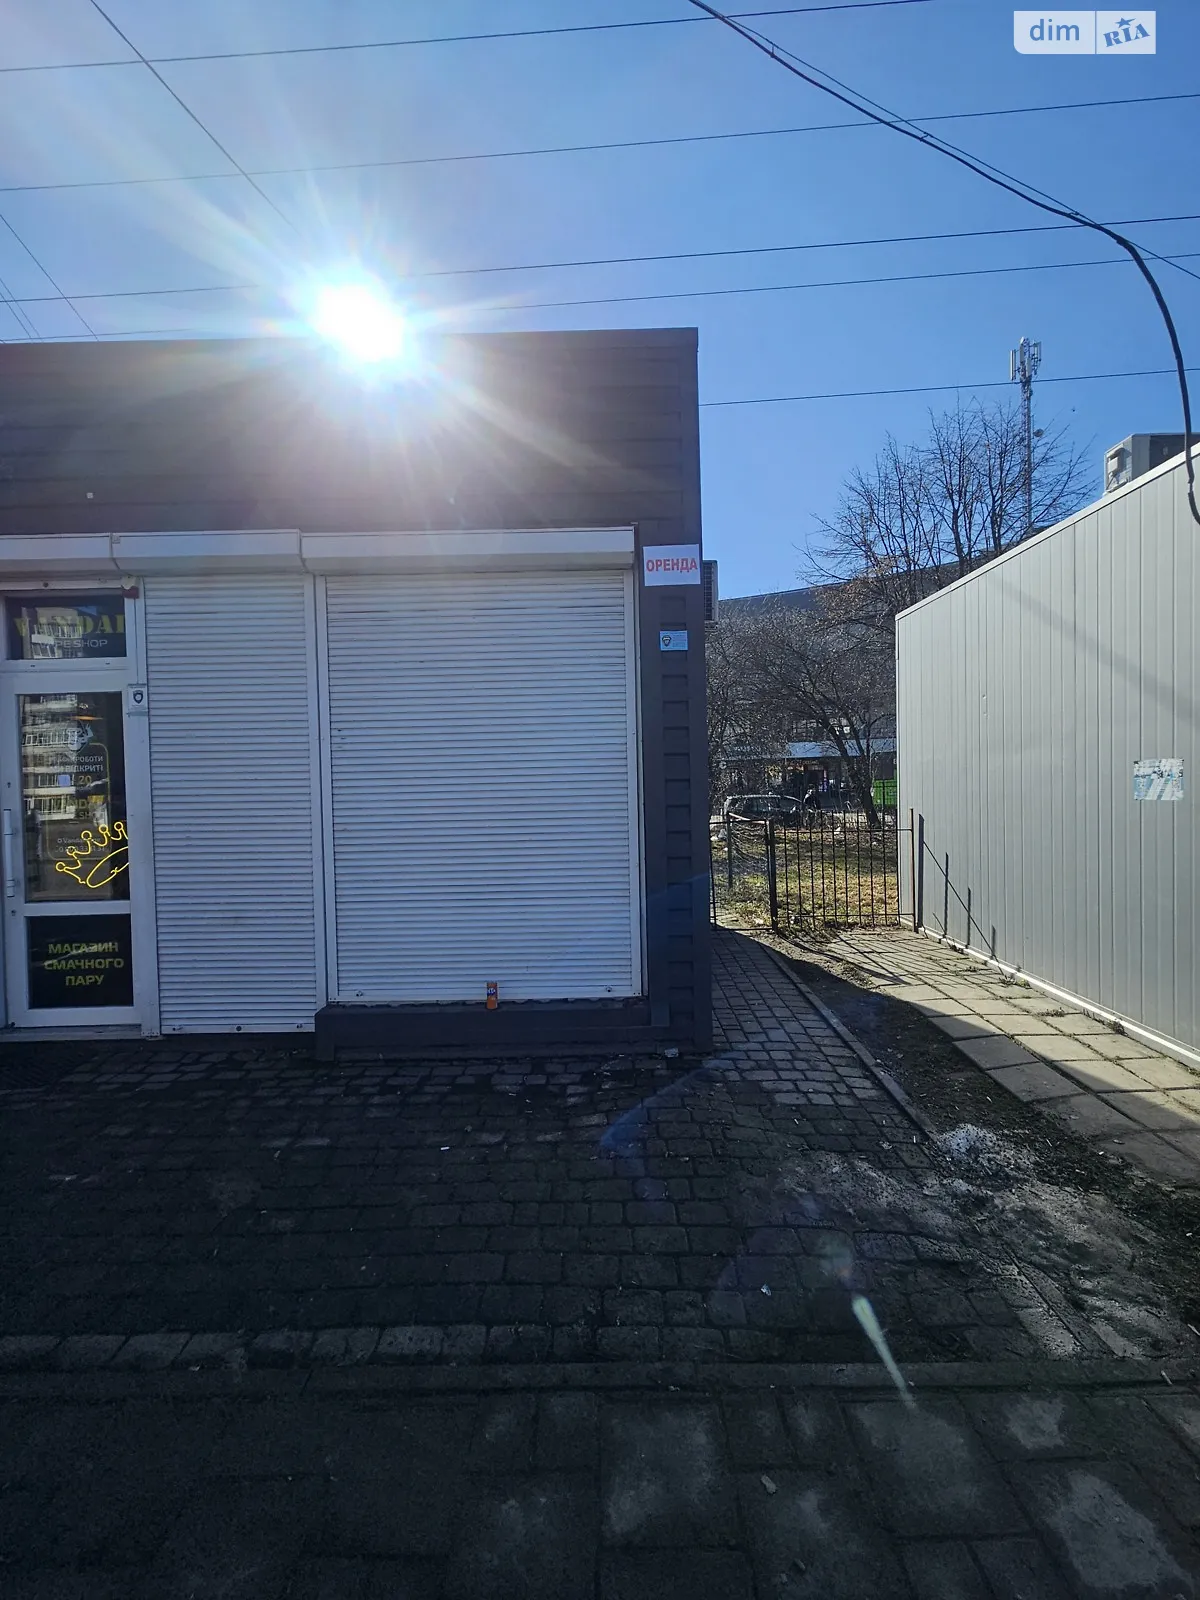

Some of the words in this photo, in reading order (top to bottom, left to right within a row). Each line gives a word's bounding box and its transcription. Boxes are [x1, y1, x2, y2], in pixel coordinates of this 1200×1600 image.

[646, 558, 698, 573] ОРЕНДА
[73, 638, 108, 649] SHOP
[48, 942, 119, 954] МАГАЗИН
[44, 958, 125, 970] СМАЧНОГО
[65, 974, 105, 986] ПАРУ
